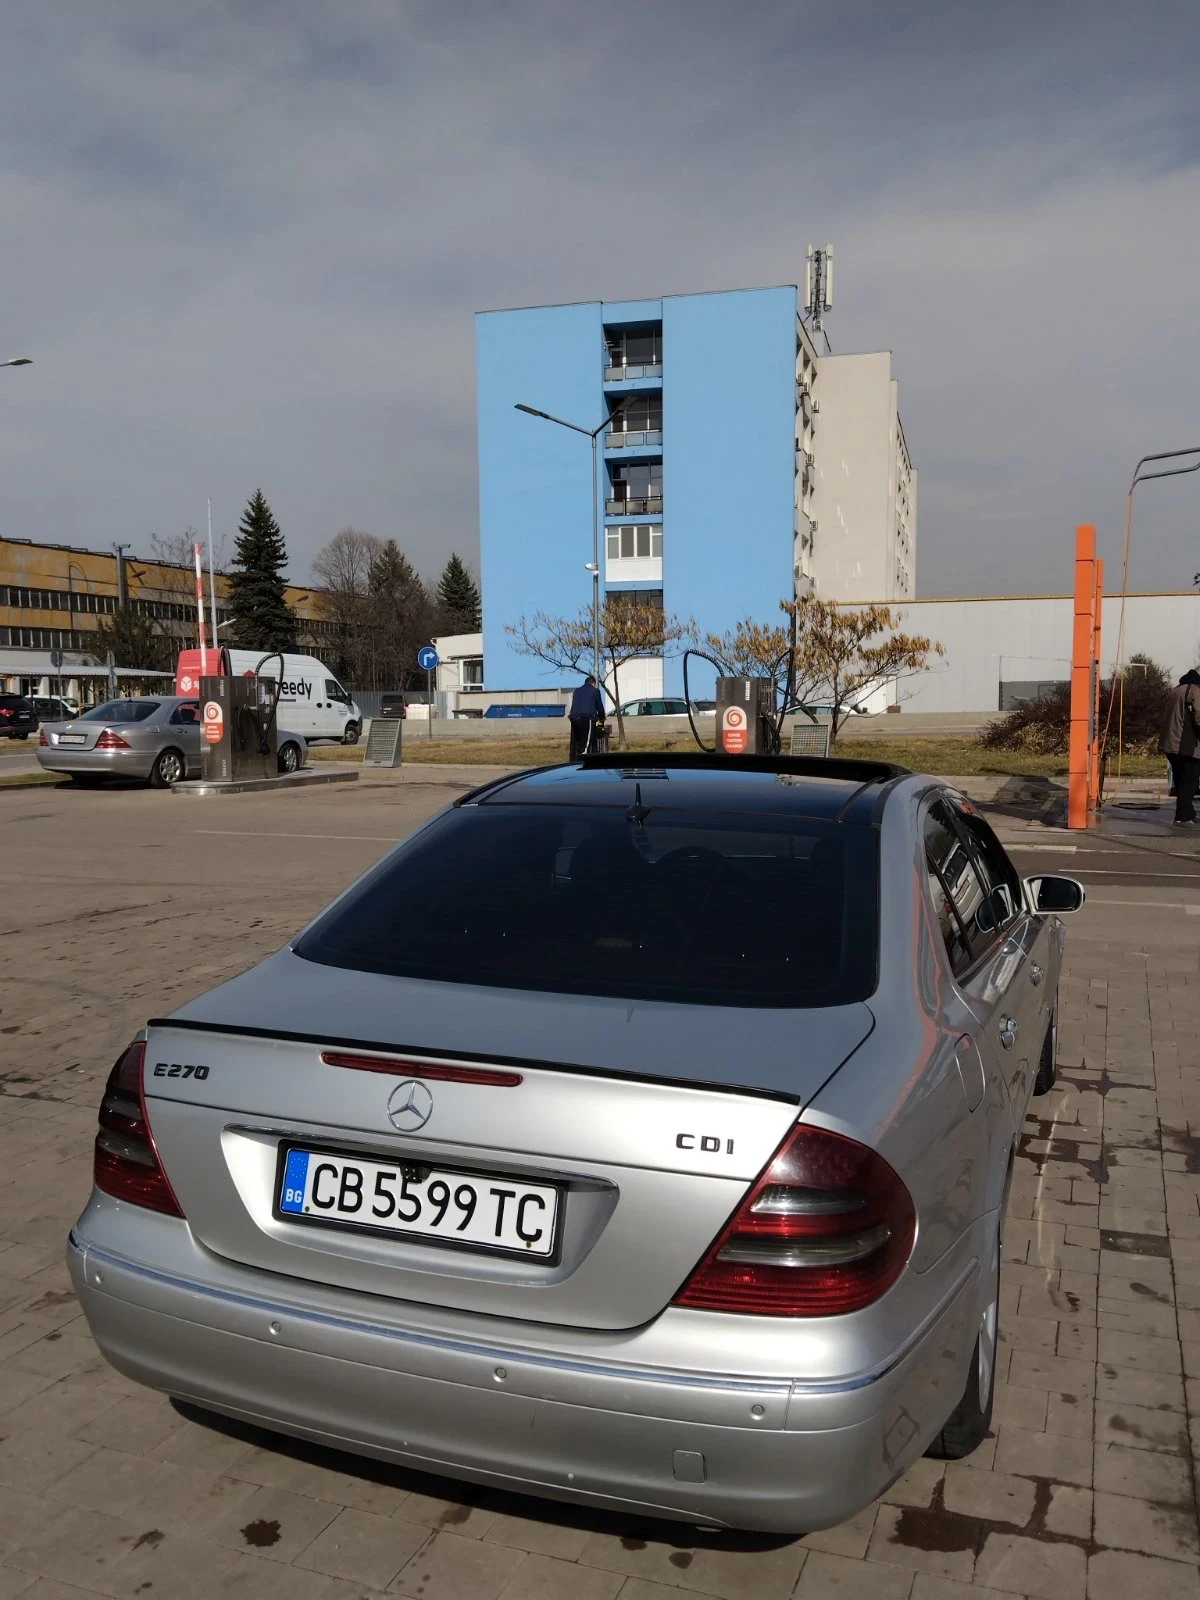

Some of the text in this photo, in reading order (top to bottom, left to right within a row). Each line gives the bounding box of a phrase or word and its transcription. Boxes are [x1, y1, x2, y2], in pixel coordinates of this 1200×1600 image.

[275, 678, 312, 700] eedy
[153, 1062, 210, 1080] E270
[675, 1132, 735, 1155] CDI
[285, 1188, 303, 1204] BG
[311, 1163, 546, 1243] CB 5599 TC
